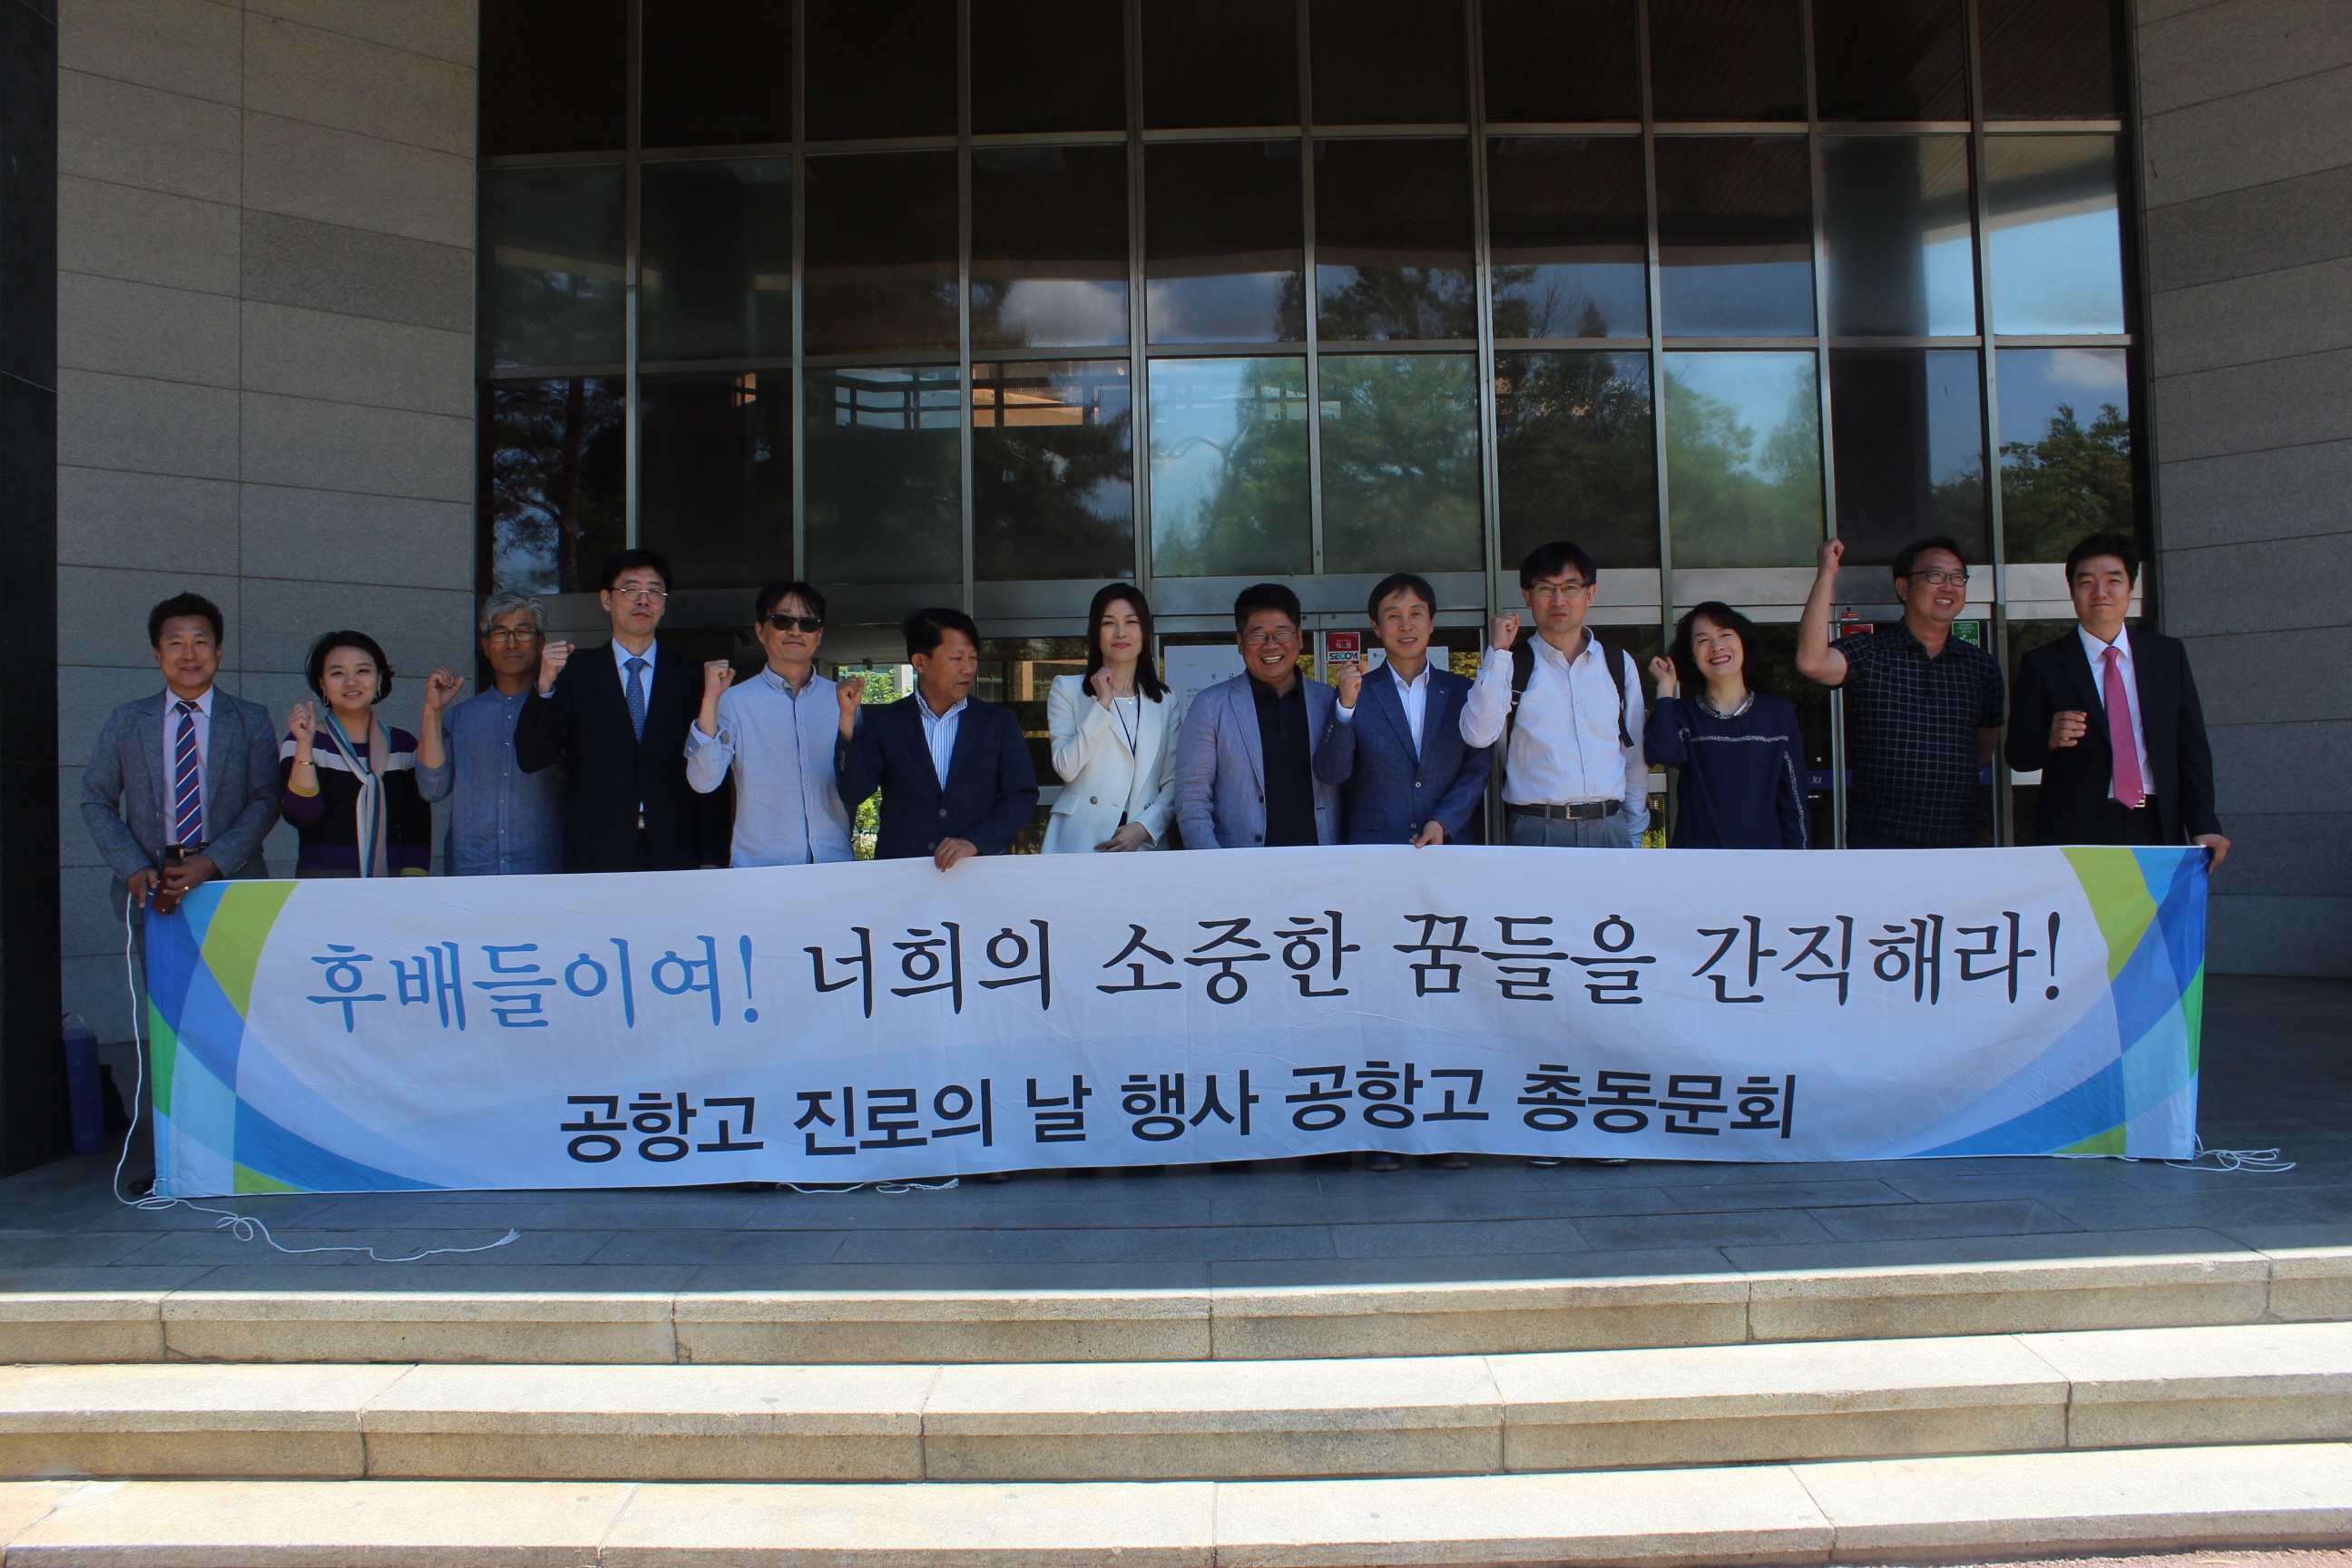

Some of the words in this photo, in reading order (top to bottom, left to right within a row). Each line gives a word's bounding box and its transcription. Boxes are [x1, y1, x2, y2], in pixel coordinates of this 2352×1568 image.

[306, 936, 759, 1034] 후배들이여!
[803, 919, 1051, 1020] 너희의
[1096, 910, 1361, 1005] 소중한
[1393, 914, 1657, 1004] 꿈들을
[1692, 911, 2061, 1007] 간직해라!
[561, 1093, 764, 1164] 공항고
[793, 1079, 993, 1157] 진로의
[1027, 1075, 1093, 1143] 날
[1122, 1070, 1259, 1142] 행사
[1286, 1062, 1490, 1132] 공항고
[1518, 1064, 1796, 1140] 총동문회
